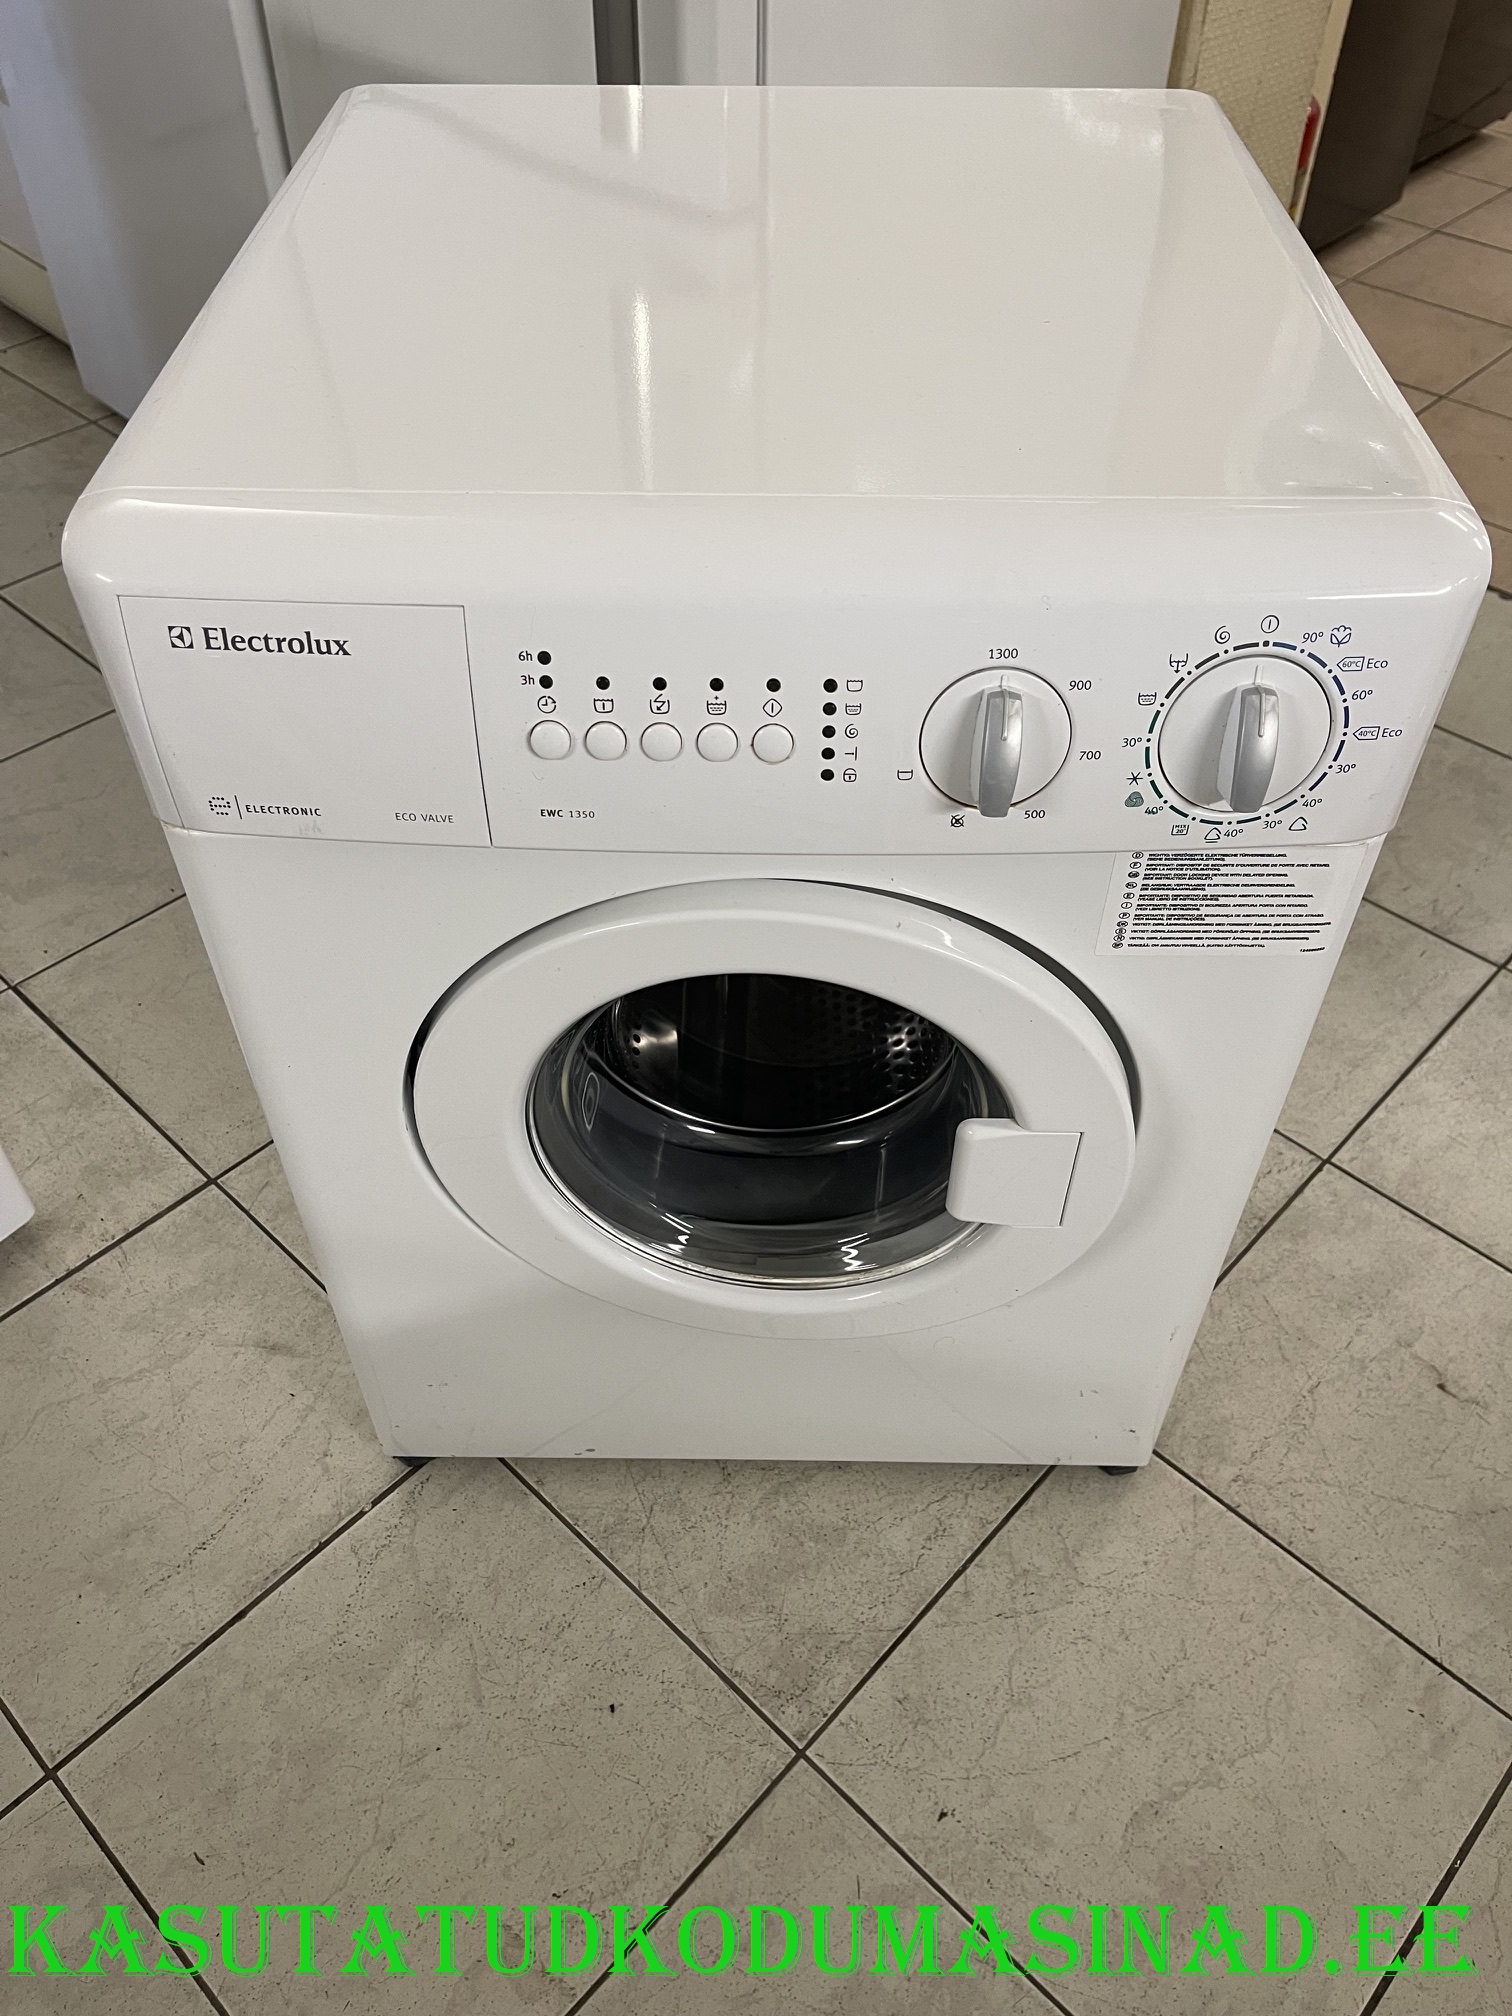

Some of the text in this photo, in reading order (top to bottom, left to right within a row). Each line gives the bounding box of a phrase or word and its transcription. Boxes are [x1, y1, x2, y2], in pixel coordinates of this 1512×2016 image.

[201, 627, 351, 656] Electrolux
[518, 651, 532, 662] 6h
[989, 648, 1018, 659] 1300
[1366, 659, 1388, 668] Eco
[521, 676, 534, 686] 3h
[1069, 680, 1091, 690] 900
[1382, 728, 1402, 738] Eco
[1079, 751, 1101, 760] 700
[245, 804, 322, 817] ELECTRONIC
[540, 809, 595, 818] EWC 1350
[1024, 810, 1045, 819] 500
[395, 812, 454, 823] ECO VALVE
